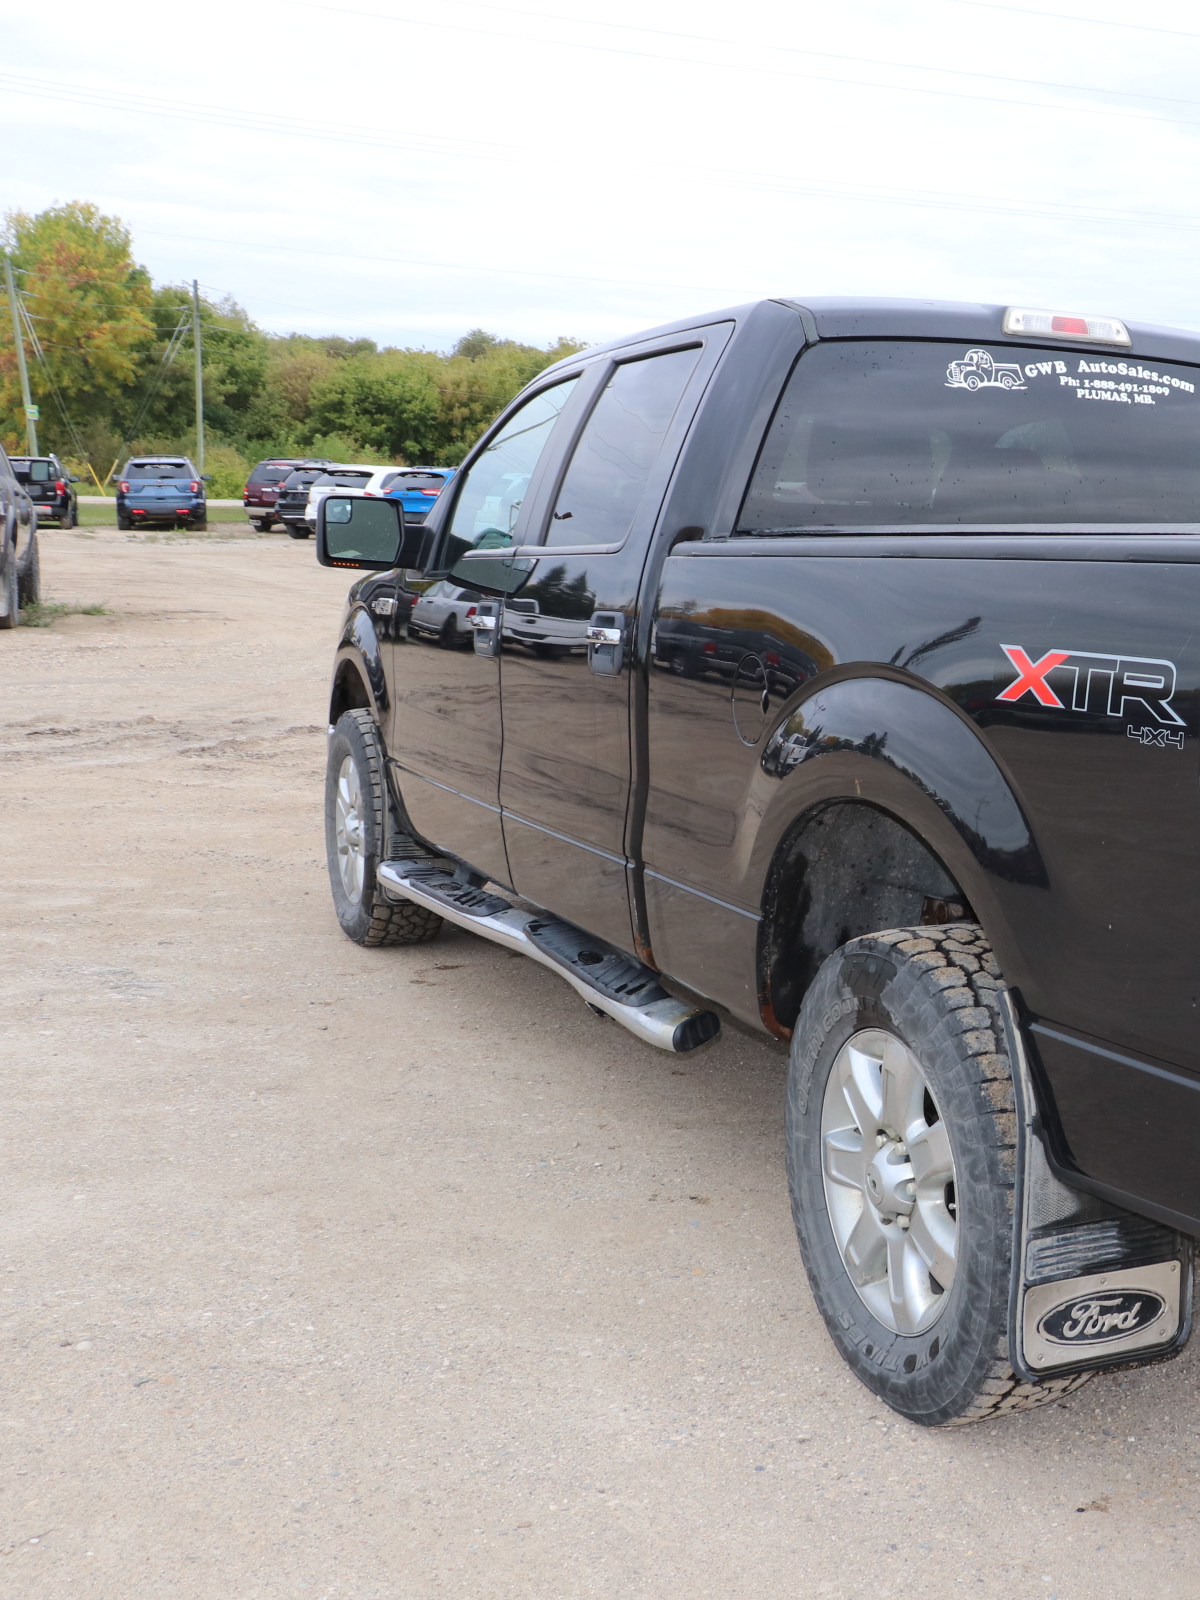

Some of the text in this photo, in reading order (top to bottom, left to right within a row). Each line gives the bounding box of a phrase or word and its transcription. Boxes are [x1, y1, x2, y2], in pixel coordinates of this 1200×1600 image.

[1024, 359, 1195, 394] GWB AutoSales.com
[1059, 375, 1170, 397] Ph: 1-888-491-1809
[1076, 388, 1156, 405] PLUMAS, MB.
[995, 643, 1187, 726] XTR
[797, 1027, 825, 1116] OPEN
[1062, 1297, 1143, 1339] Ford
